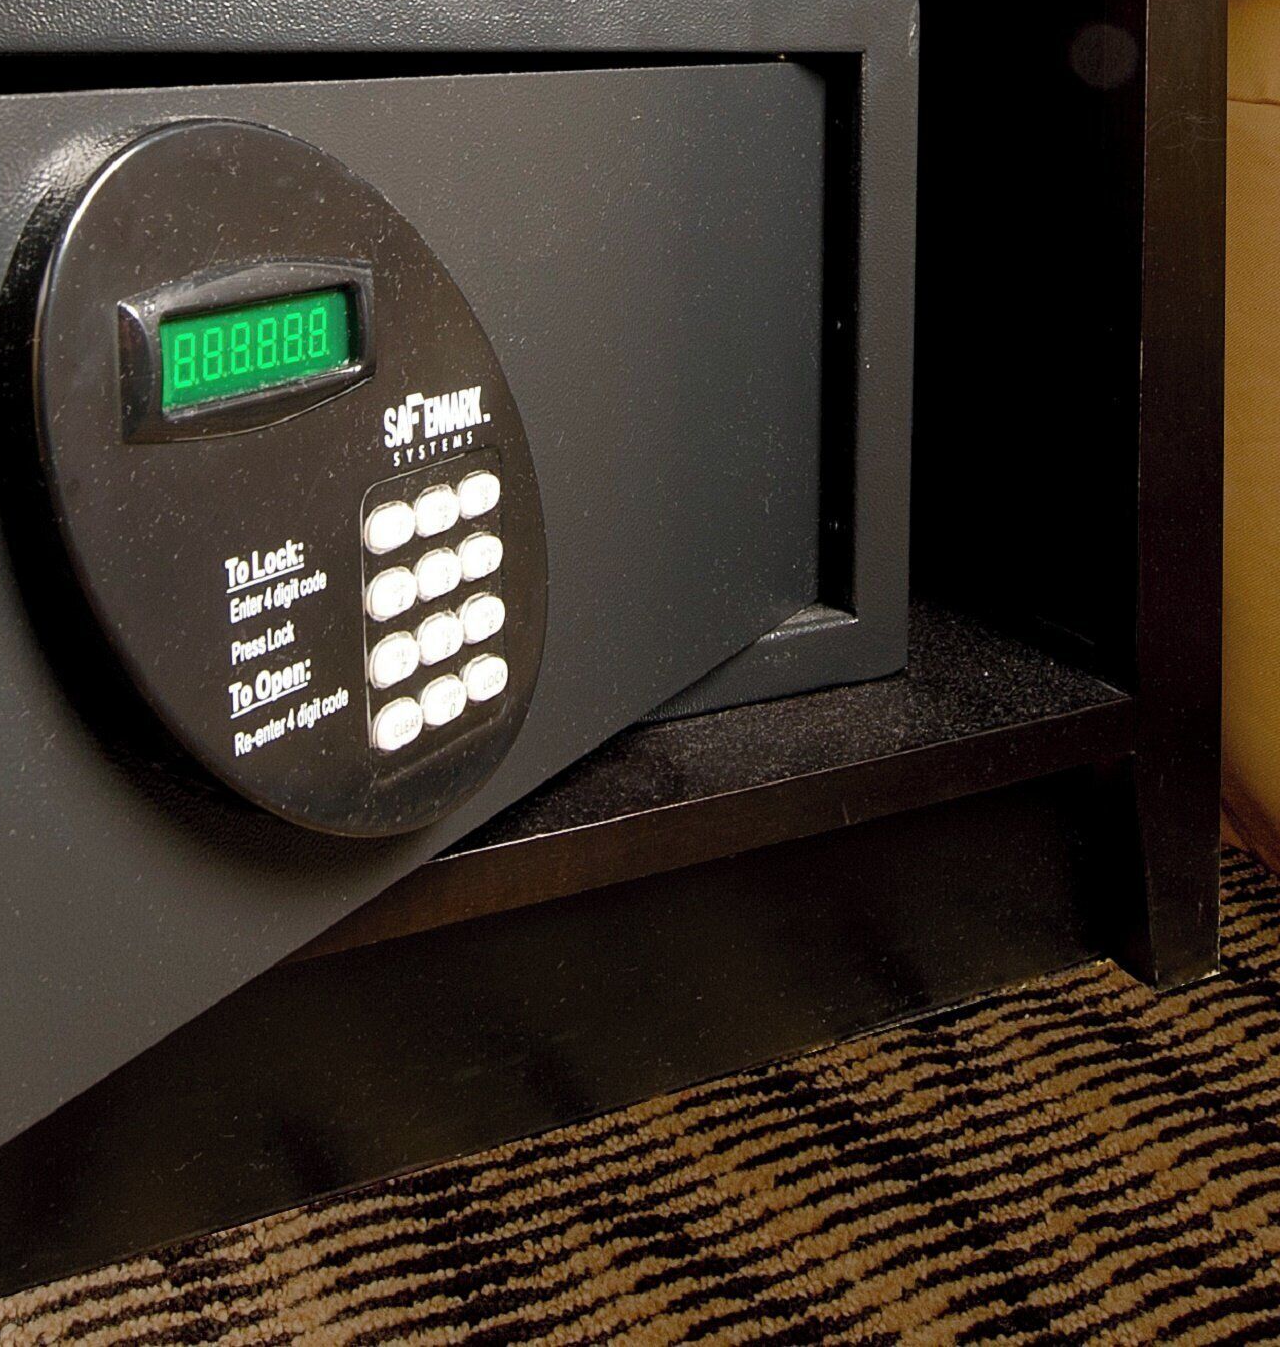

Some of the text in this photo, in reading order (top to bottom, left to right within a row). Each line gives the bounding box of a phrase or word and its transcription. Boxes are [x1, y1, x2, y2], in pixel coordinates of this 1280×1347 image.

[383, 385, 483, 448] SAFEMARK
[393, 430, 473, 467] SYSTEMS
[225, 539, 304, 588] To Lock:
[230, 569, 327, 624] Enter 4 digit code
[231, 620, 295, 665] Press Lock
[228, 658, 312, 713] To Open:
[482, 670, 505, 691] LOCK
[234, 687, 350, 757] Re-enter 4 digit code
[393, 714, 420, 738] CLEAR
